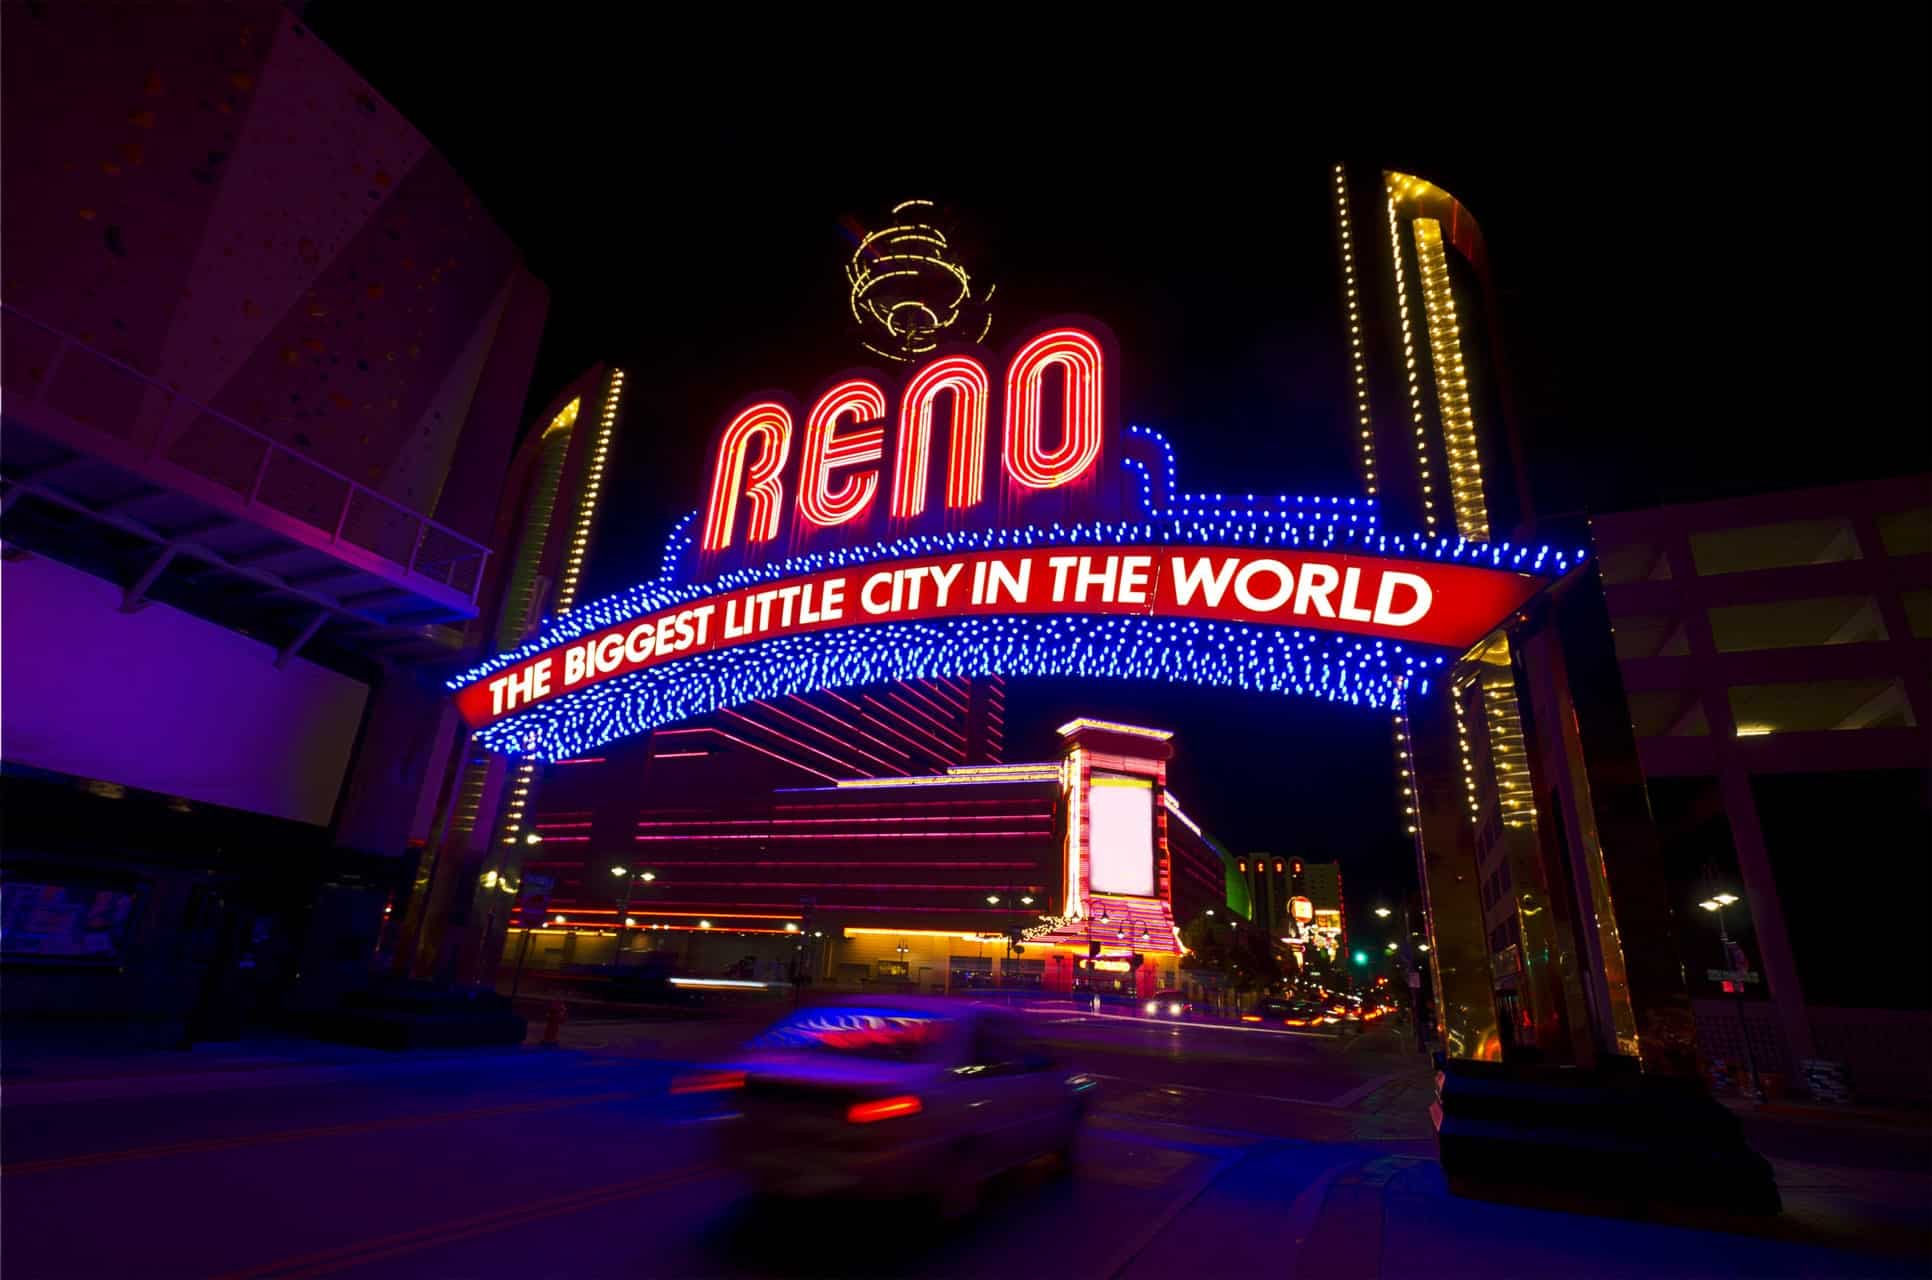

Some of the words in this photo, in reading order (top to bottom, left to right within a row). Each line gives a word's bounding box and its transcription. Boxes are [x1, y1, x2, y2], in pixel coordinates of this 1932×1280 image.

[702, 327, 1103, 551] RENO
[489, 657, 552, 716] THE
[564, 604, 715, 680] BIGGEST
[724, 577, 845, 639] LITTLE
[860, 563, 964, 615] CITY
[971, 558, 1032, 605] IN
[1049, 555, 1152, 604] THE
[1171, 556, 1433, 627] WORLD
